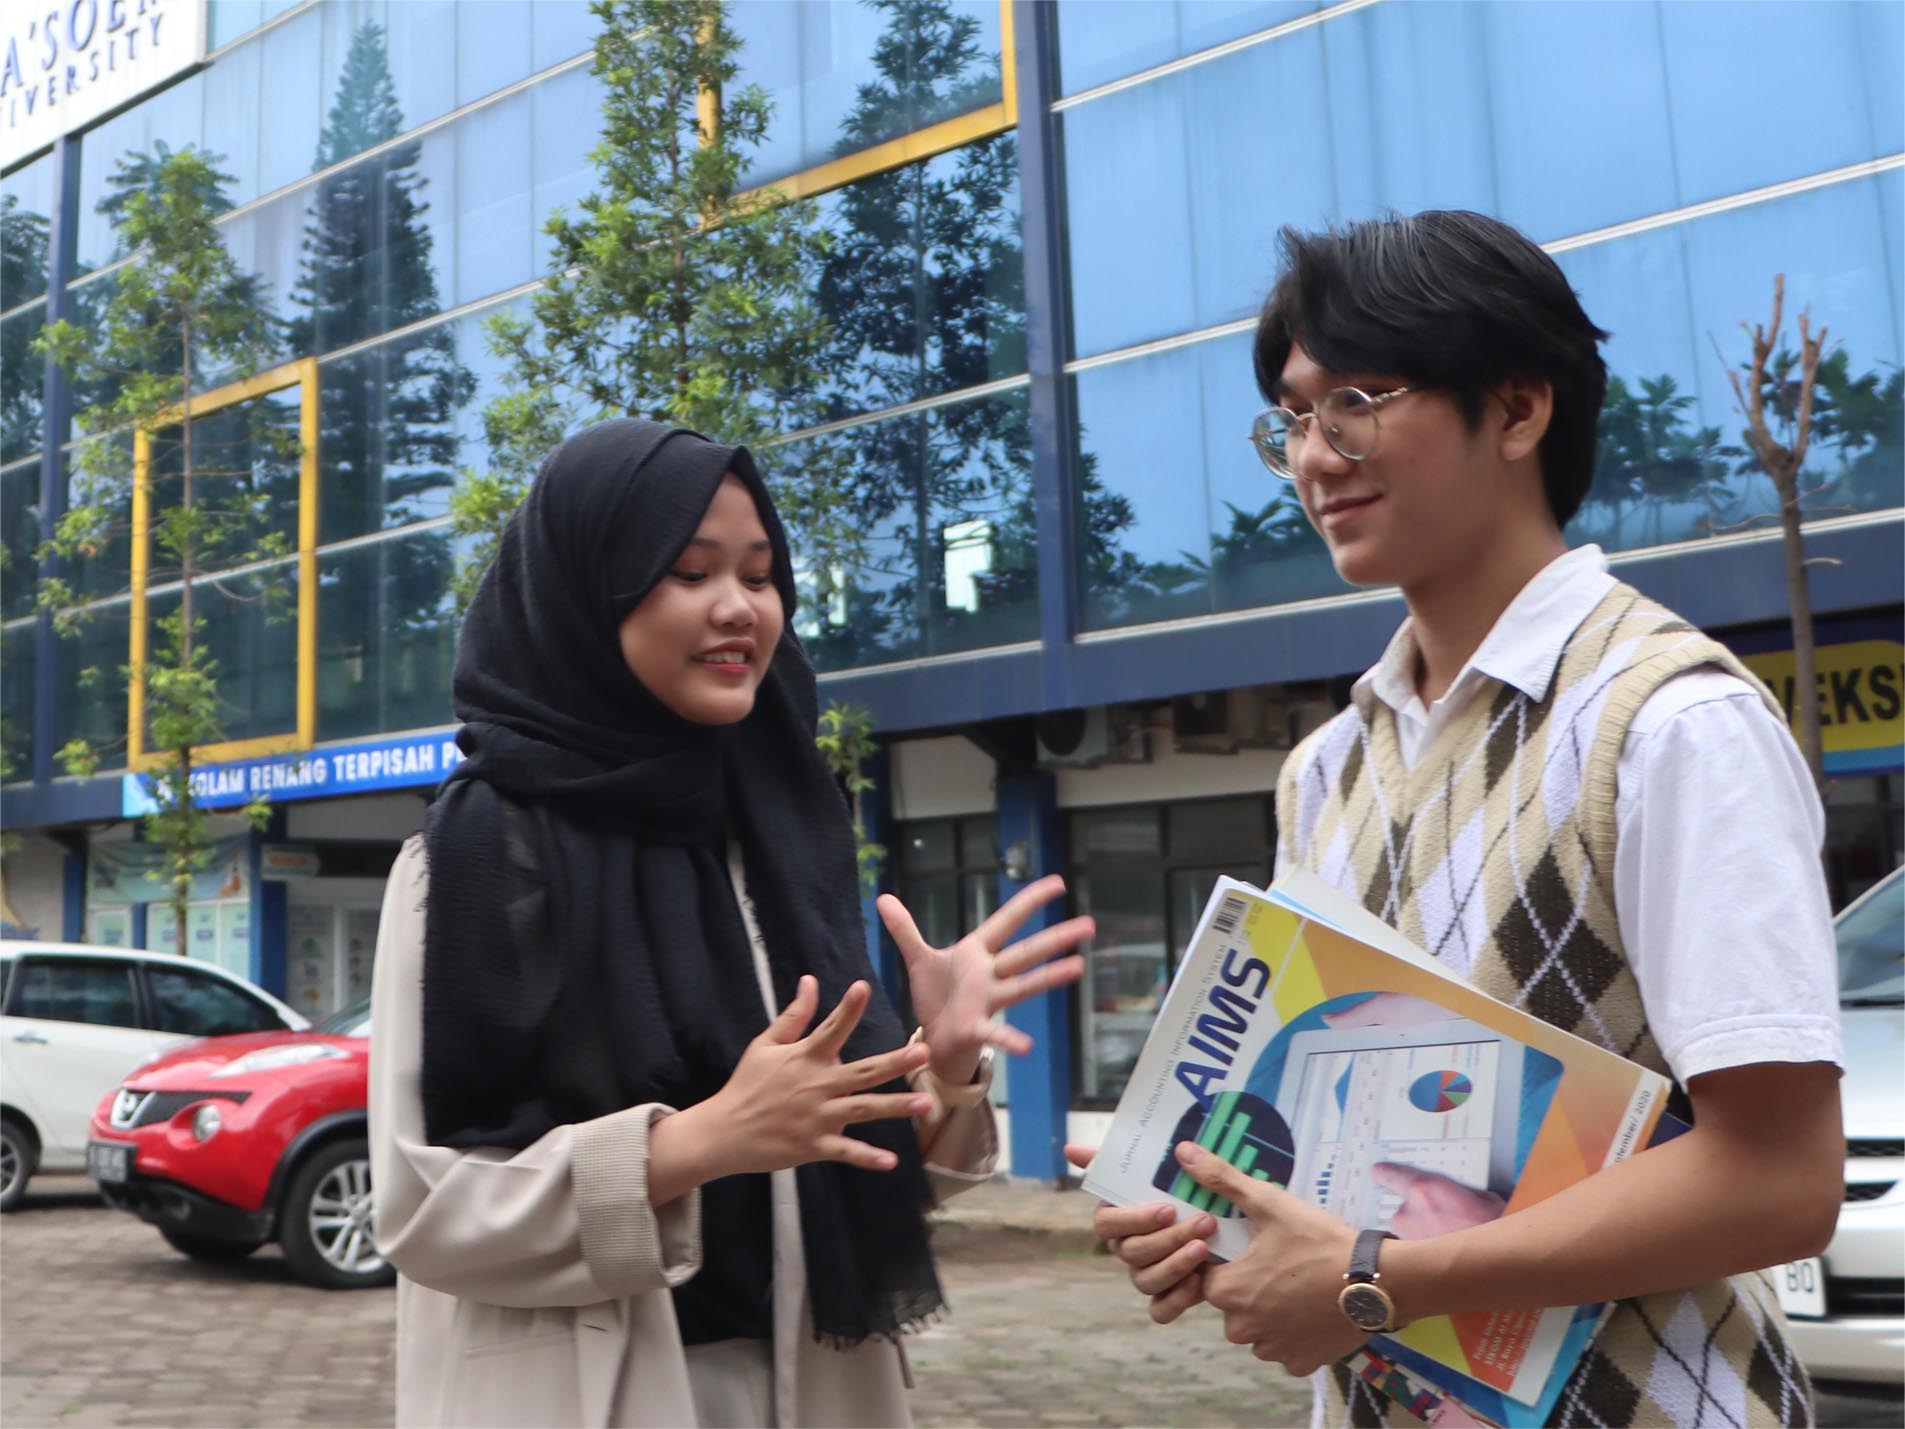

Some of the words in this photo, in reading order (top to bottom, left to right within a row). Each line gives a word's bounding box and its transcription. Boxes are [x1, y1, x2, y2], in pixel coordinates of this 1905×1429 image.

[250, 757, 327, 791] RENANG
[333, 743, 435, 781] TERPISAH
[1174, 948, 1271, 1112] AIMS
[1634, 1089, 1651, 1115] 2020
